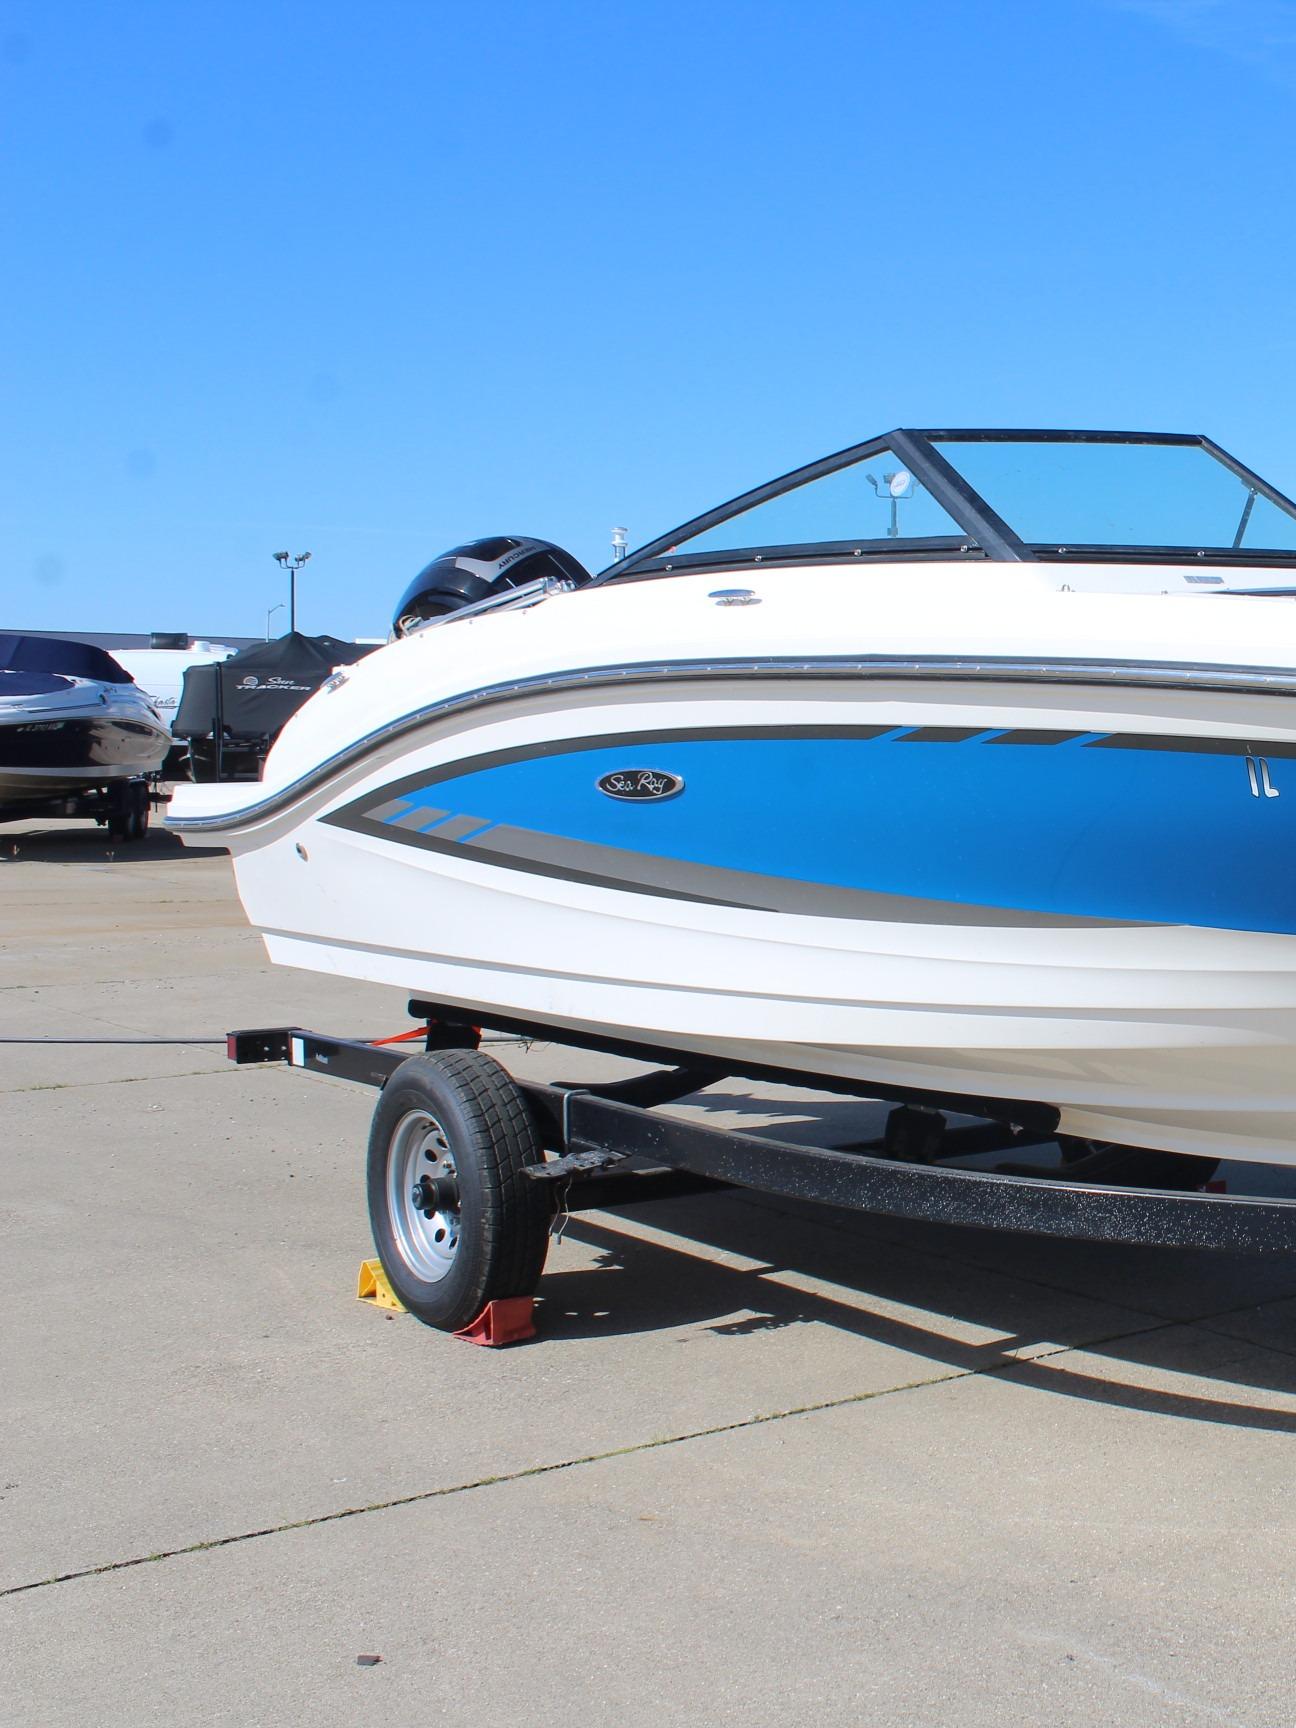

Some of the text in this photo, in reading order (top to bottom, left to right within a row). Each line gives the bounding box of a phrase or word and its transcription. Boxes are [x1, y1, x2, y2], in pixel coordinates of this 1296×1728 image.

[266, 676, 295, 685] Sun
[606, 771, 668, 794] Sea Ray
[1245, 756, 1280, 798] IL
